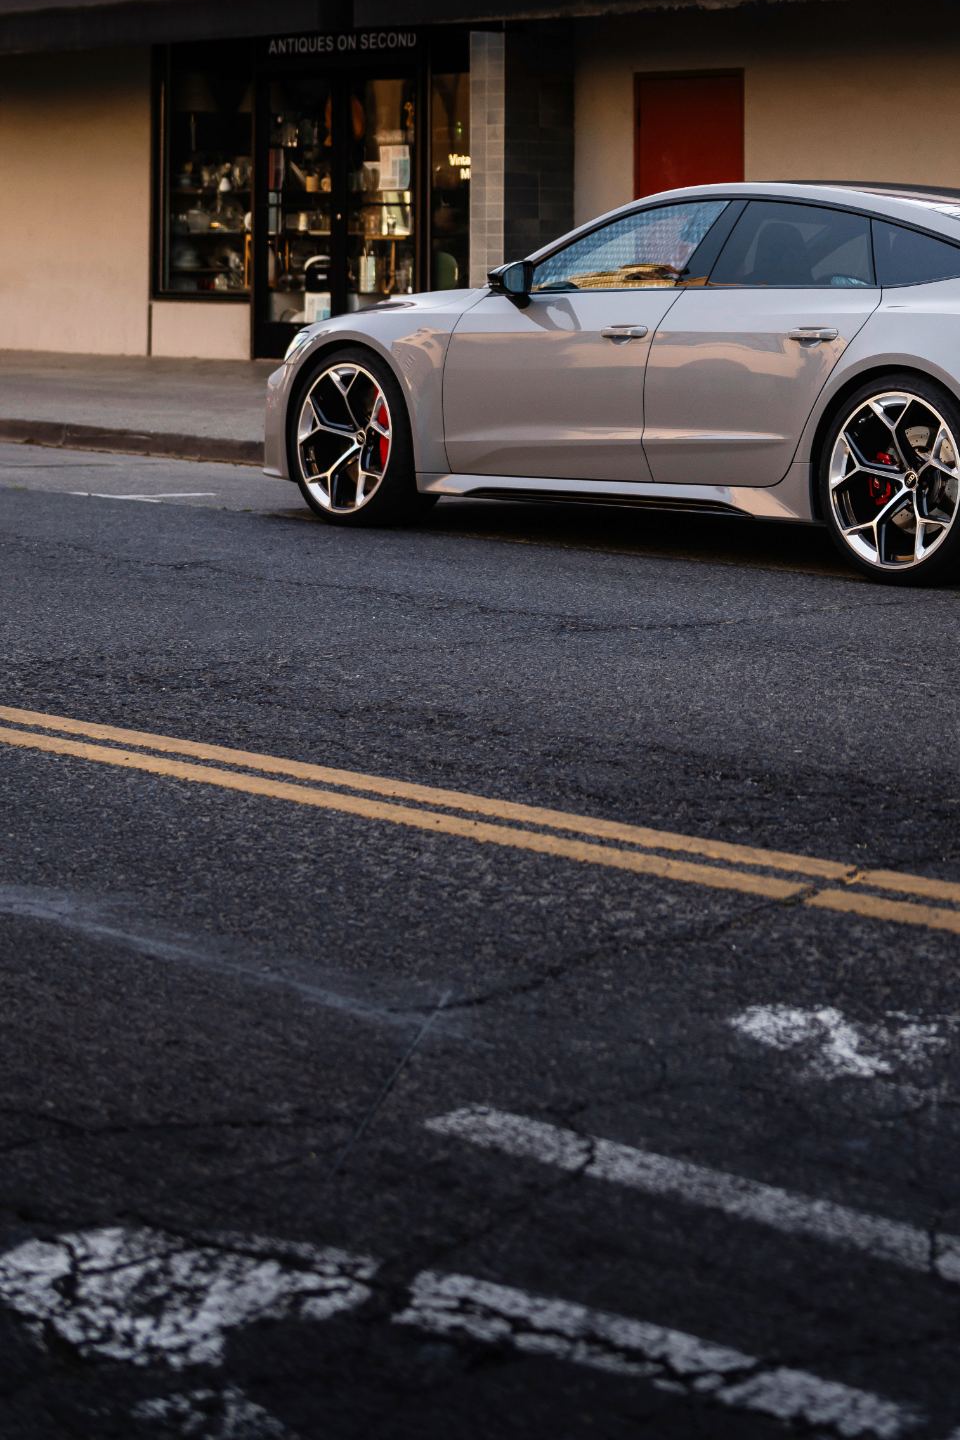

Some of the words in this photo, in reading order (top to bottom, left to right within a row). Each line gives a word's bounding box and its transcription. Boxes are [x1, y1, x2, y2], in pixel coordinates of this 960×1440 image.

[268, 36, 334, 55] ANTIQUES
[337, 34, 356, 50] ON
[360, 32, 417, 49] SECOND
